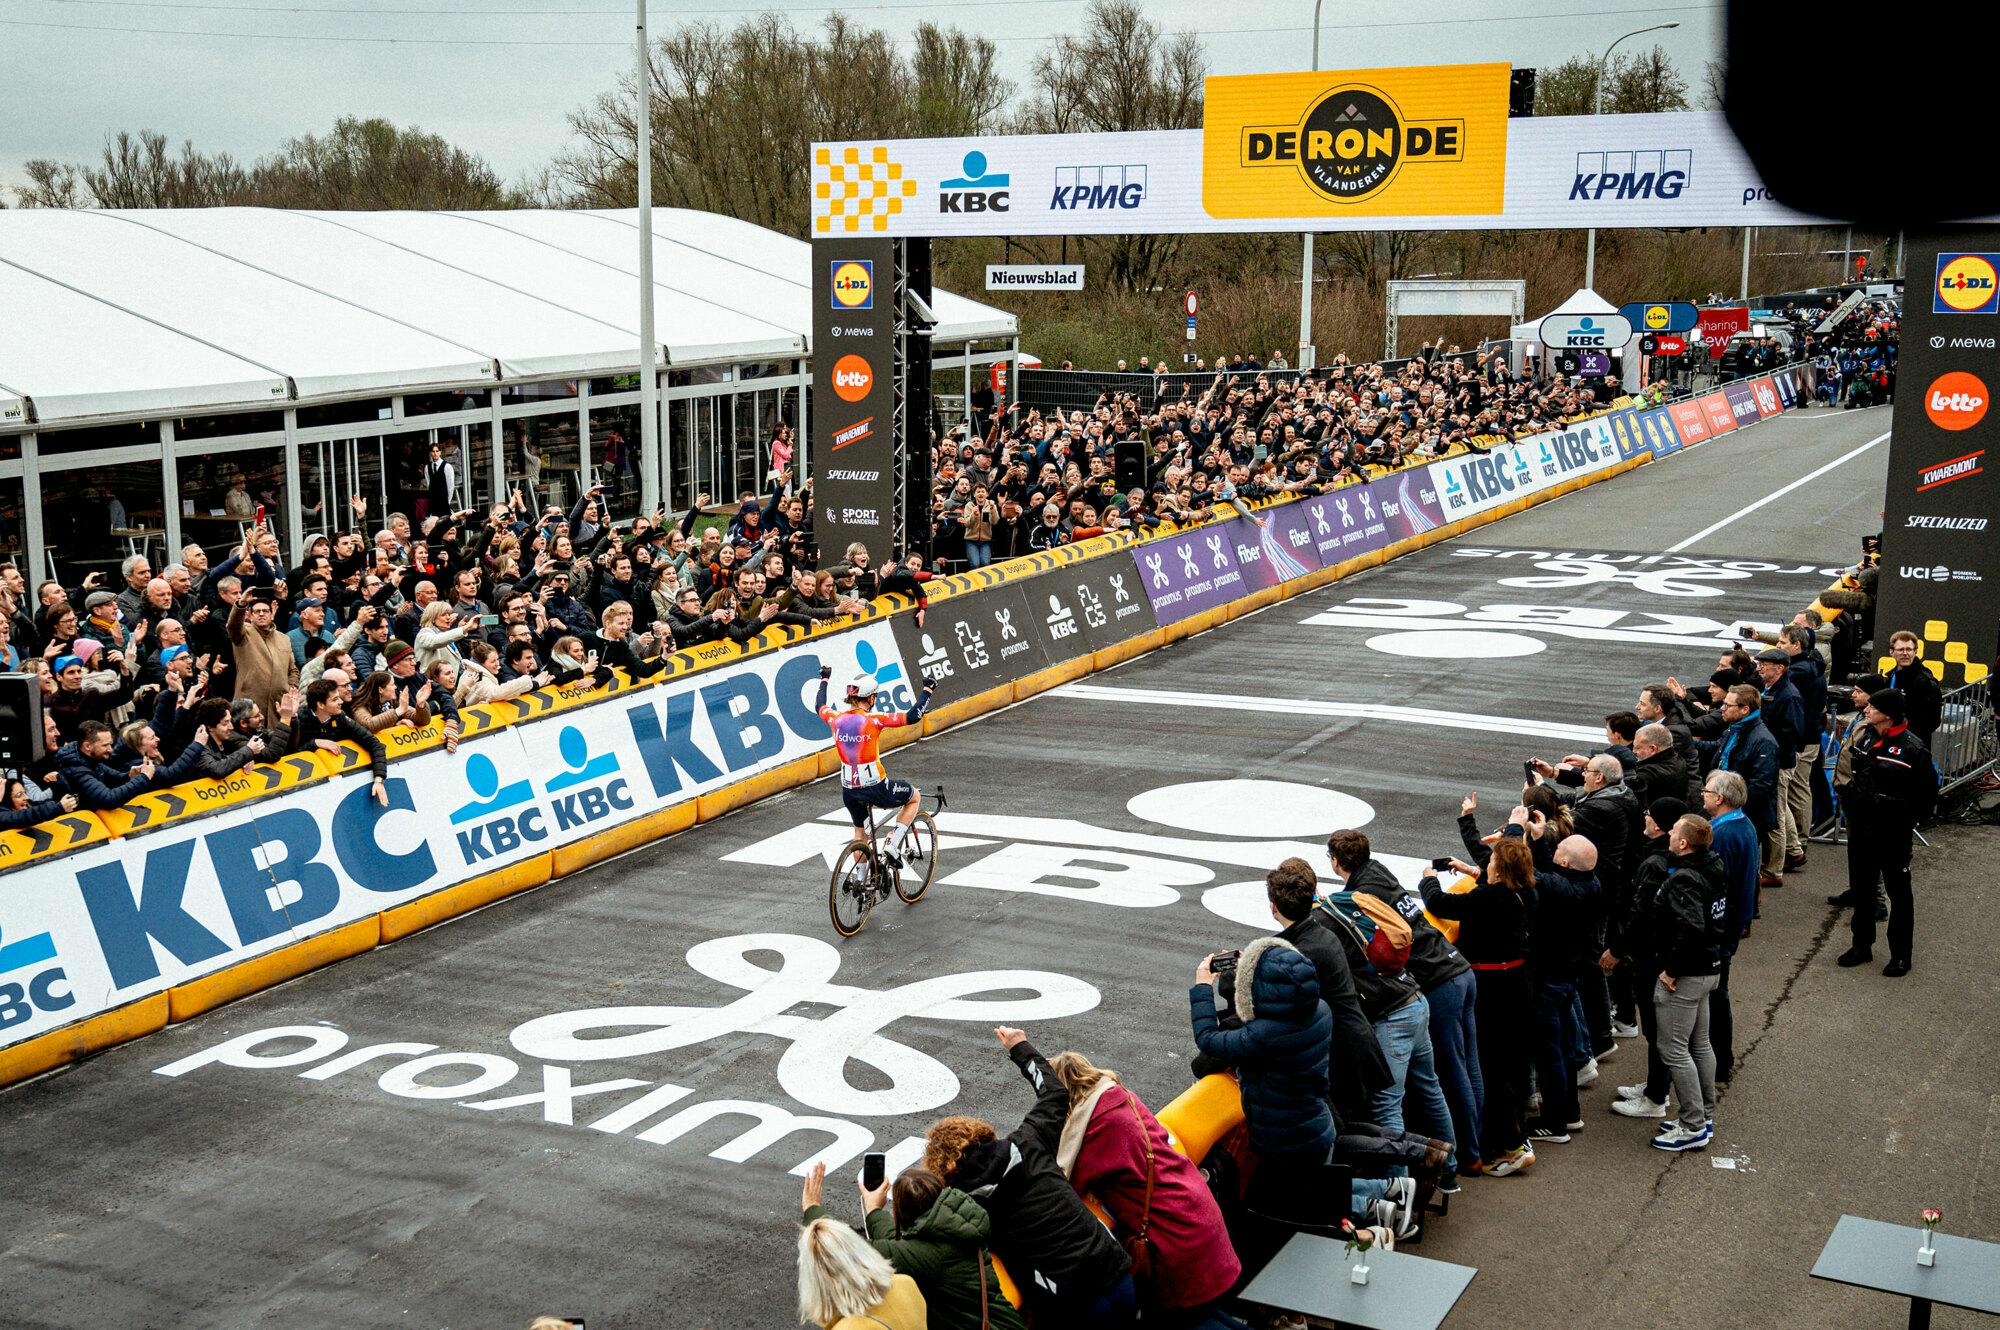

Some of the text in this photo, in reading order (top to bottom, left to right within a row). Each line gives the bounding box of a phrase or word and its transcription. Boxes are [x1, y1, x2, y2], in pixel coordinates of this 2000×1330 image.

[1248, 126, 1458, 161] DE RON DE
[1314, 163, 1386, 191] VLAANDEREN
[1337, 165, 1360, 175] VAN
[1568, 170, 1686, 201] KPMG
[940, 191, 1010, 214] KBC
[1051, 183, 1144, 210] KPMG
[991, 270, 1077, 285] Nieuwsblad
[844, 327, 874, 337] mewa
[1567, 336, 1605, 346] KBC
[1660, 341, 1680, 350] lotto
[1950, 337, 1996, 349] mewa
[835, 369, 870, 387] lotto
[1931, 390, 1983, 412] lotto
[4, 410, 21, 418] BHV
[836, 422, 870, 446] KWAREMONT
[1551, 426, 1600, 473] KBC
[1600, 442, 1614, 458] KBC
[826, 469, 880, 481] SPECIALIZED
[1460, 451, 1515, 503] KBC
[1517, 470, 1533, 486] KBC
[1542, 462, 1558, 478] KBC
[1923, 456, 1978, 485] KWAREMONT
[1418, 488, 1438, 506] fiber
[1448, 492, 1464, 509] KBC
[1381, 500, 1401, 519] fiber
[842, 517, 880, 526] VLAANDEREN
[1904, 515, 1988, 531] SPECIALIZED
[1288, 528, 1311, 548] fiber
[1318, 521, 1385, 555] proximus proximus proximus
[1237, 543, 1262, 565] fiber
[1005, 562, 1029, 576] boplan
[1899, 566, 1930, 580] UCI
[1152, 570, 1241, 612] proximus proximus proximus
[1115, 602, 1141, 622] proximus
[1049, 618, 1079, 641] KBC
[696, 643, 732, 661] boplan
[1000, 639, 1030, 661] proximus
[390, 724, 440, 748] boplan
[626, 653, 835, 799] KBC
[838, 731, 873, 743] sdworx
[864, 764, 873, 779] 1
[193, 776, 252, 802] boplan
[551, 777, 635, 832] KBC
[455, 806, 549, 866] KBC
[75, 776, 438, 991] KBC
[0, 966, 76, 1031] BC
